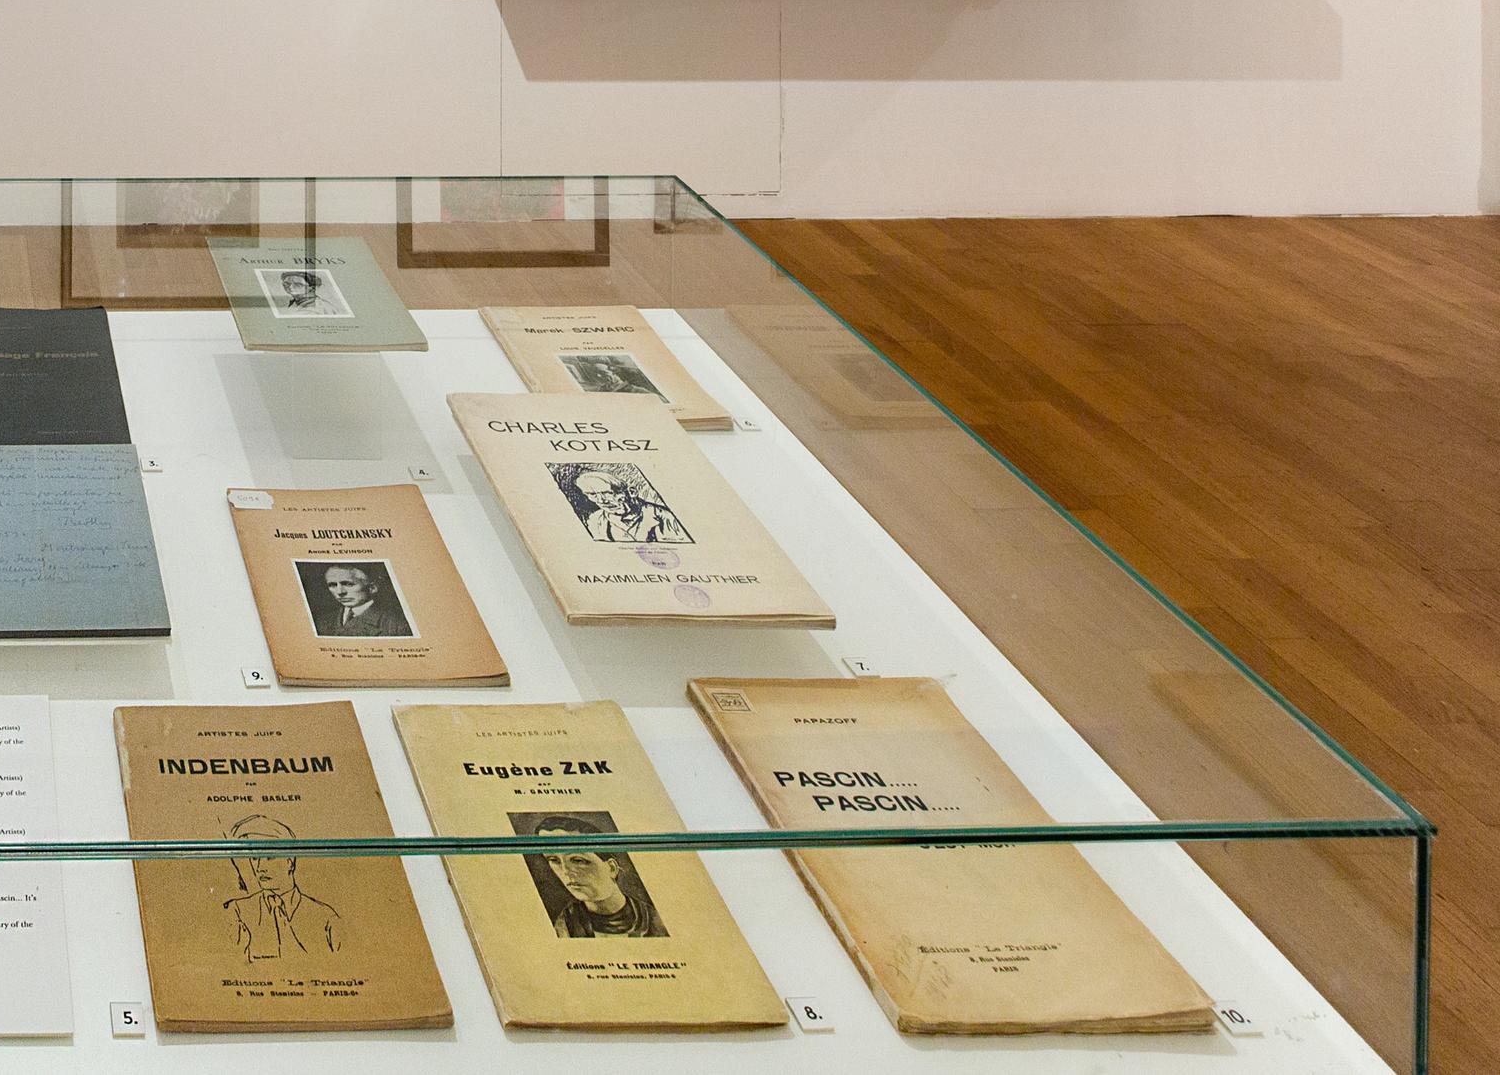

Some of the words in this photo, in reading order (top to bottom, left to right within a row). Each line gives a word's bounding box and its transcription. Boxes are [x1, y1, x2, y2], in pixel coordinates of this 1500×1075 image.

[572, 326, 635, 334] SZWARC
[488, 420, 609, 434] CHARLES
[550, 439, 659, 451] KOTASZ
[312, 528, 393, 539] LOUTCHANSKY
[577, 574, 671, 584] MAXIMILIEN
[677, 574, 761, 585] GAUTHIER
[855, 663, 870, 671] 7.
[251, 671, 264, 681] 9.
[793, 717, 858, 725] PAPAZOFF
[158, 756, 334, 775] INDENBAUM
[463, 762, 554, 779] Eugène
[559, 760, 613, 775] ZAK
[262, 794, 302, 802] BASLER
[566, 961, 606, 970] Éditions
[222, 979, 274, 987] Editions
[123, 1011, 139, 1025] 5.
[803, 1006, 823, 1020] 8.
[1221, 1009, 1251, 1024] 10.
